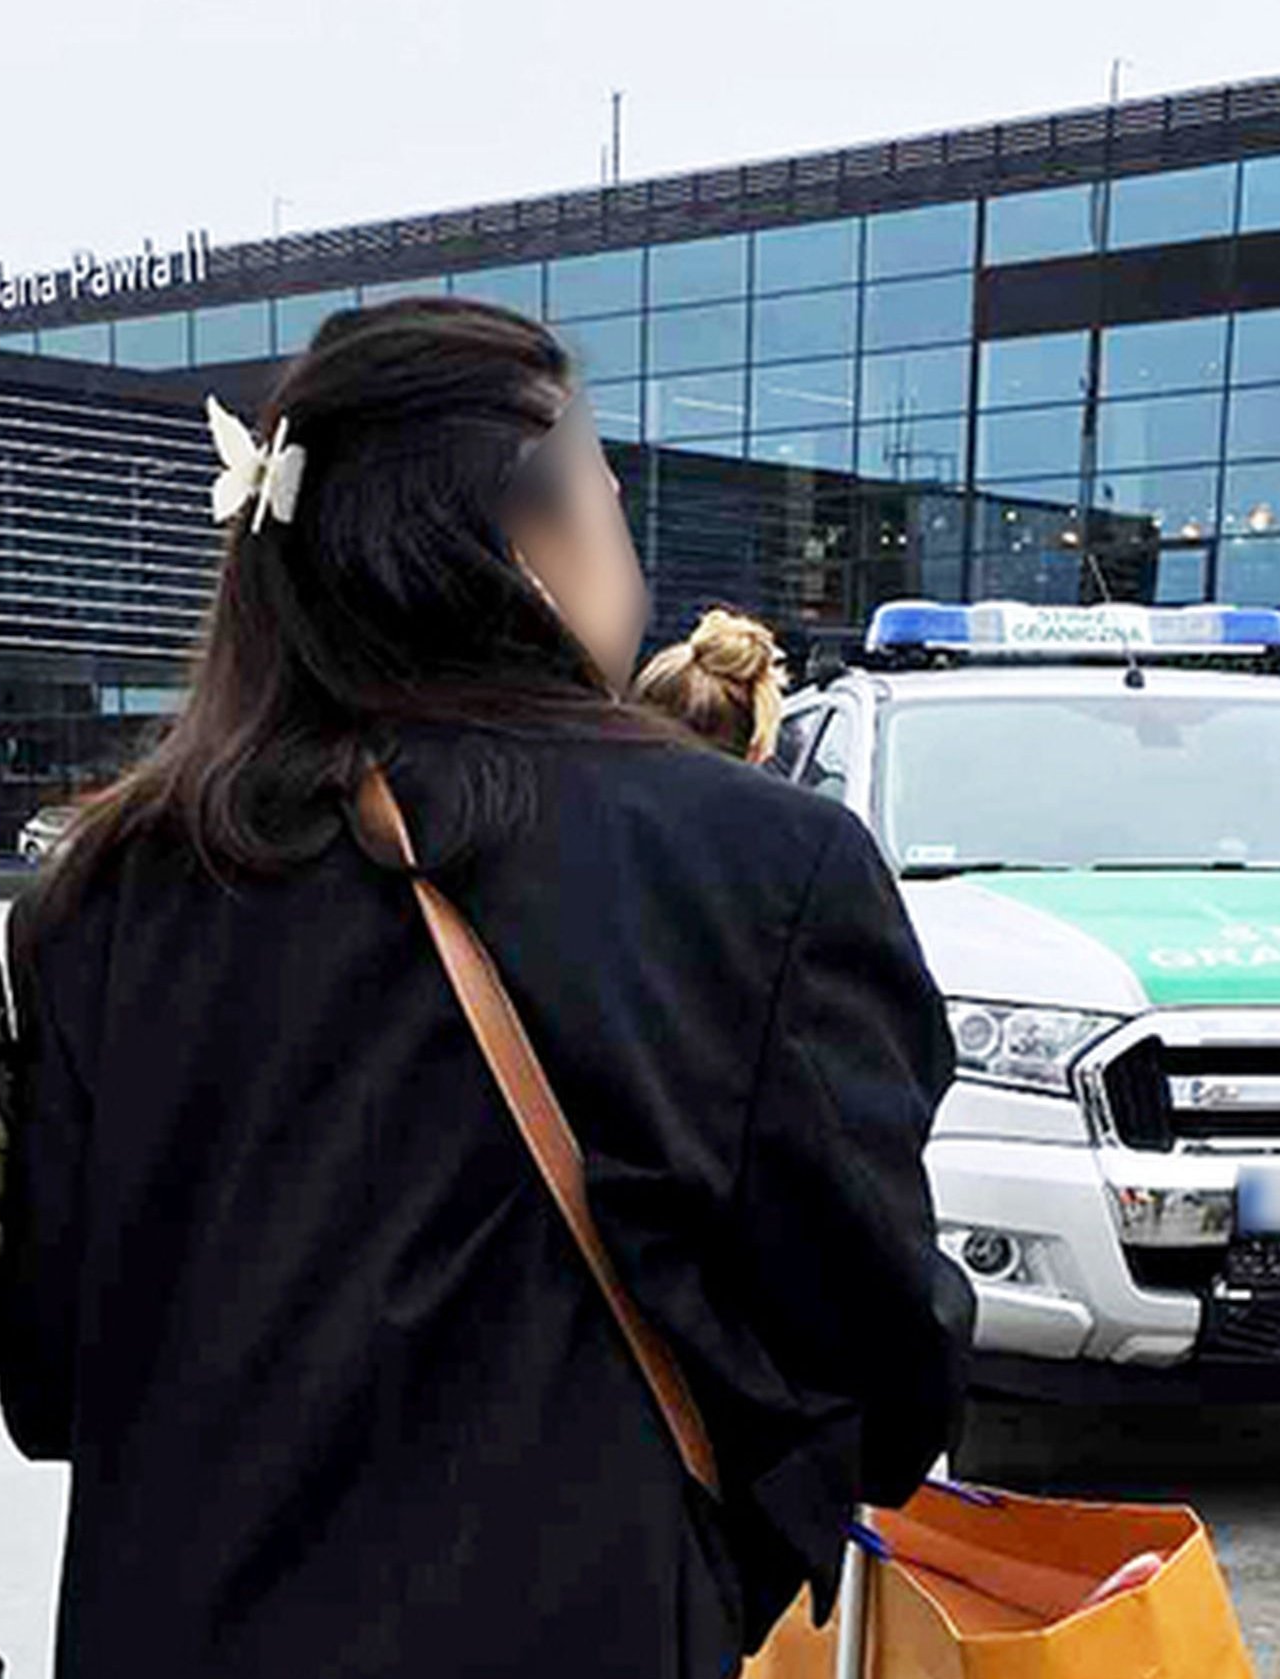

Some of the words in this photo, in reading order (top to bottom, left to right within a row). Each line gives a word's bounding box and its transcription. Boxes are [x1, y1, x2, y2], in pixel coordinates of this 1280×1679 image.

[70, 238, 172, 300] Pawła
[183, 229, 210, 283] II
[1012, 623, 1144, 642] GRANICZNA
